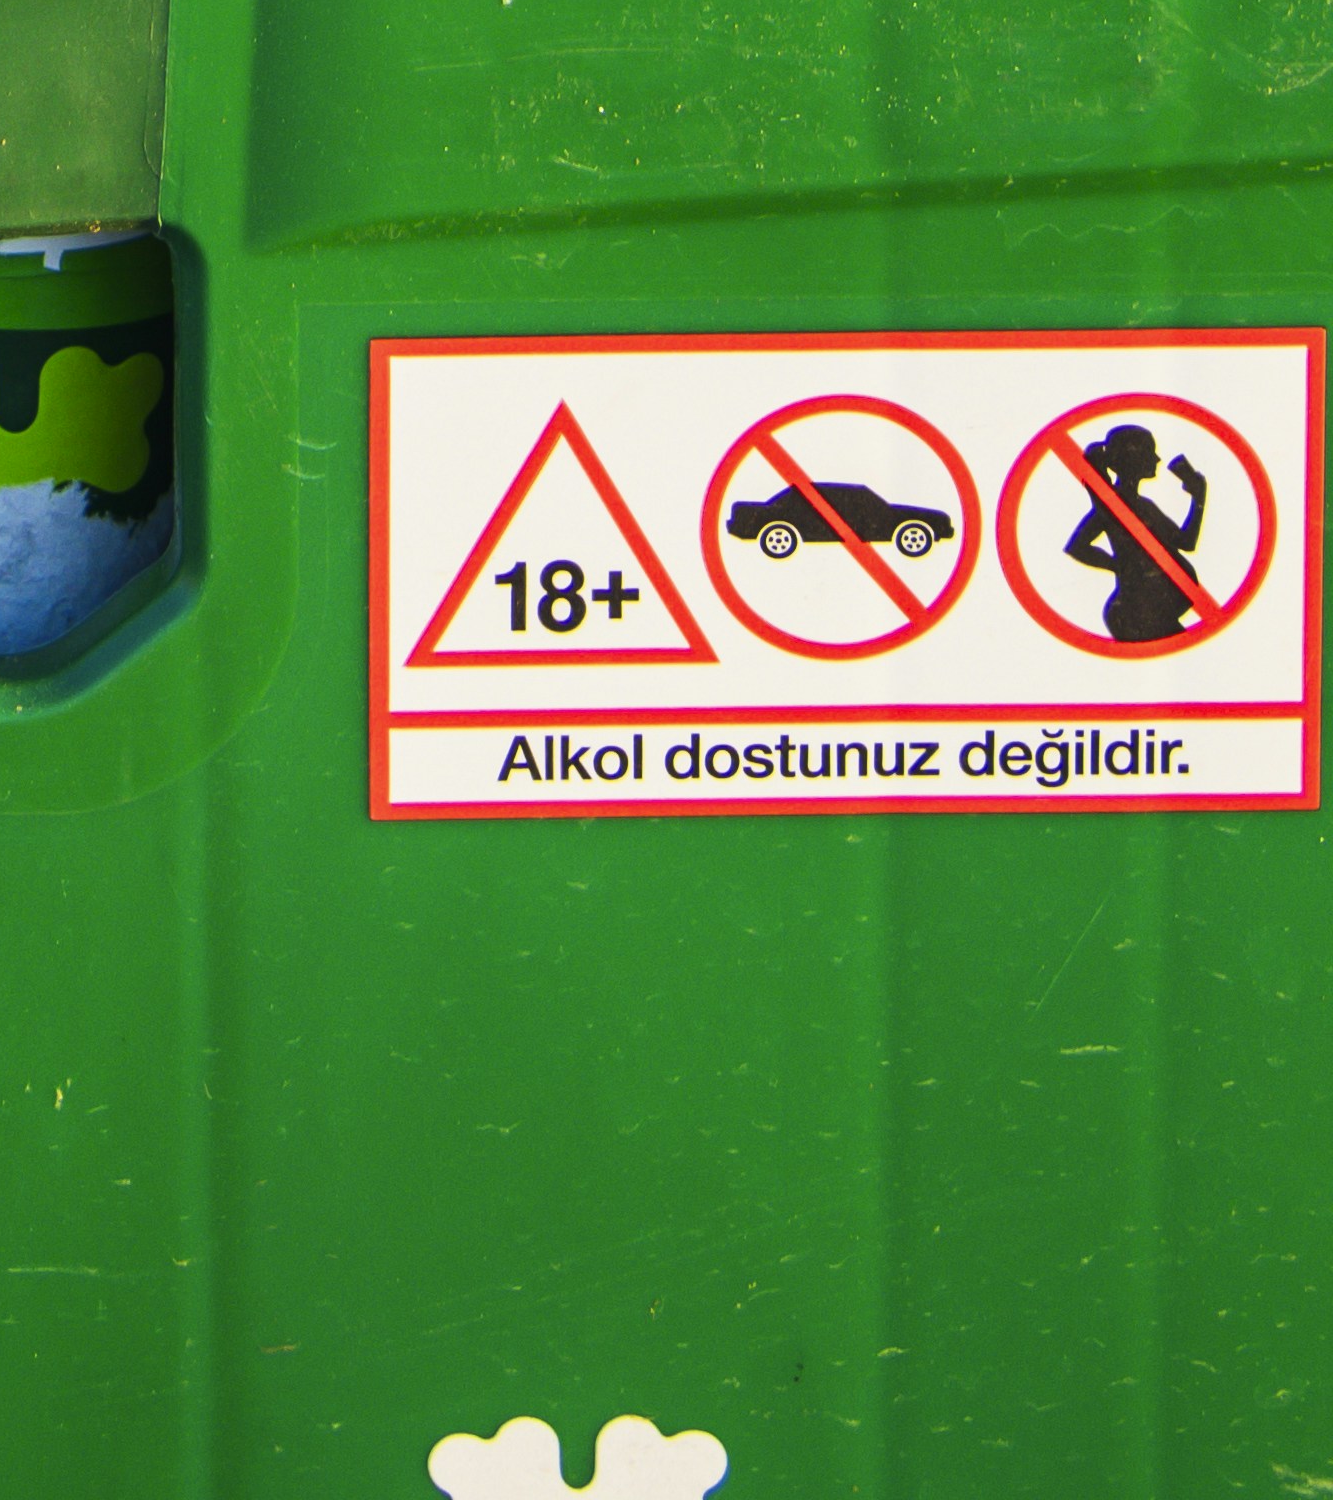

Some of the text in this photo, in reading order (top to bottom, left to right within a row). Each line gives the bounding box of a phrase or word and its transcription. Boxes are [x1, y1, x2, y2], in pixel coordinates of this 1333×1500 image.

[493, 560, 641, 633] 18+
[497, 728, 1192, 787] Alkol dostunuz değildir.
